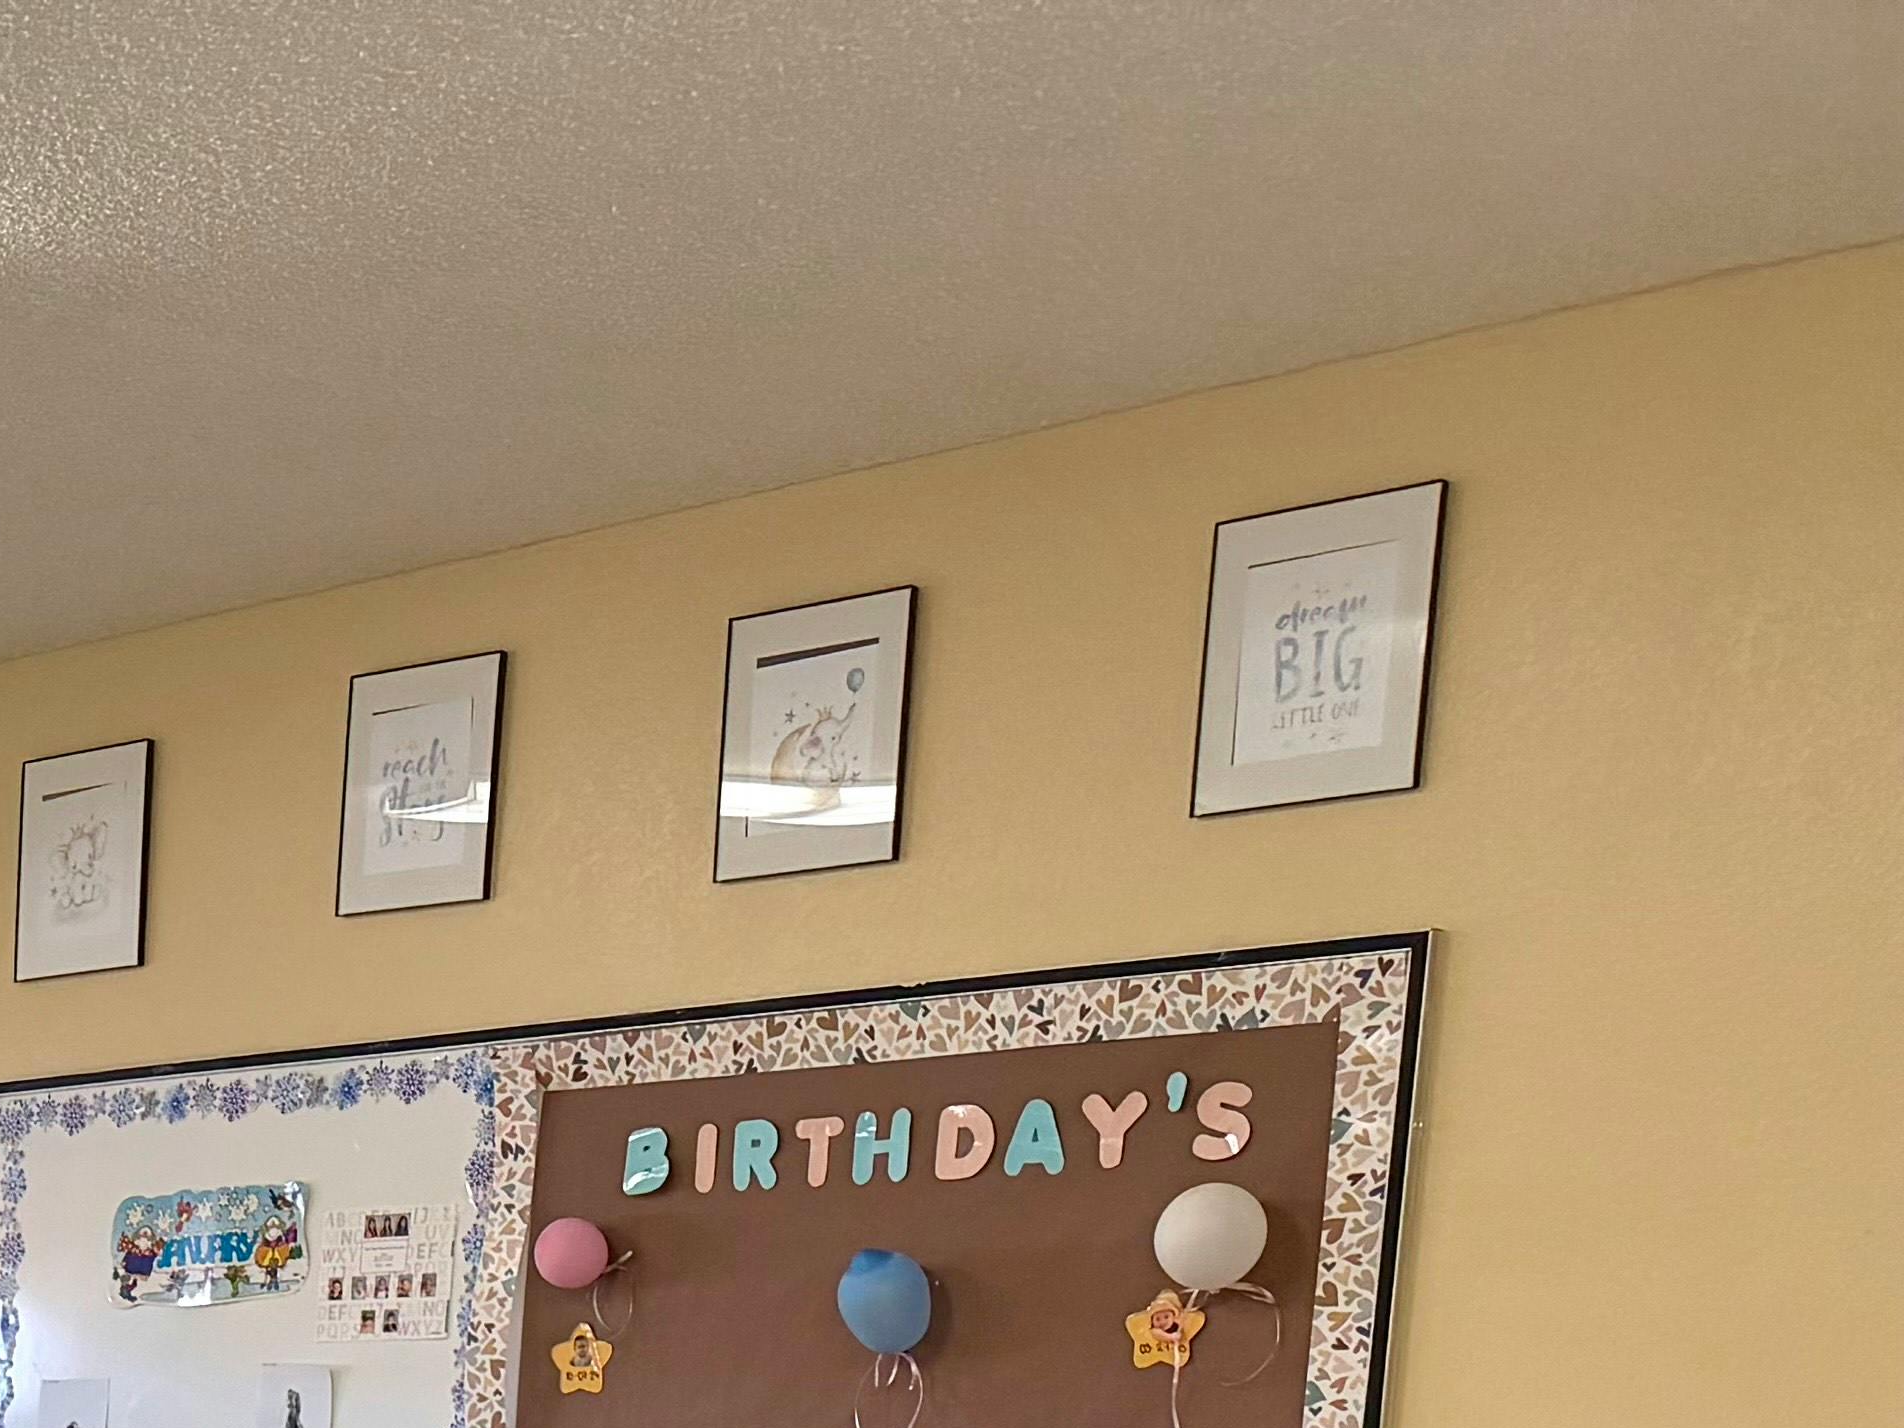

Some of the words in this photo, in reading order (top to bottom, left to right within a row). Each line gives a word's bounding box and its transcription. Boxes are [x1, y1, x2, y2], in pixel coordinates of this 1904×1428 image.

[1274, 626, 1364, 702] BIG
[382, 737, 448, 778] reach
[622, 1072, 1253, 1196] BIRTHDAY'S
[157, 1230, 260, 1269] JANUARY
